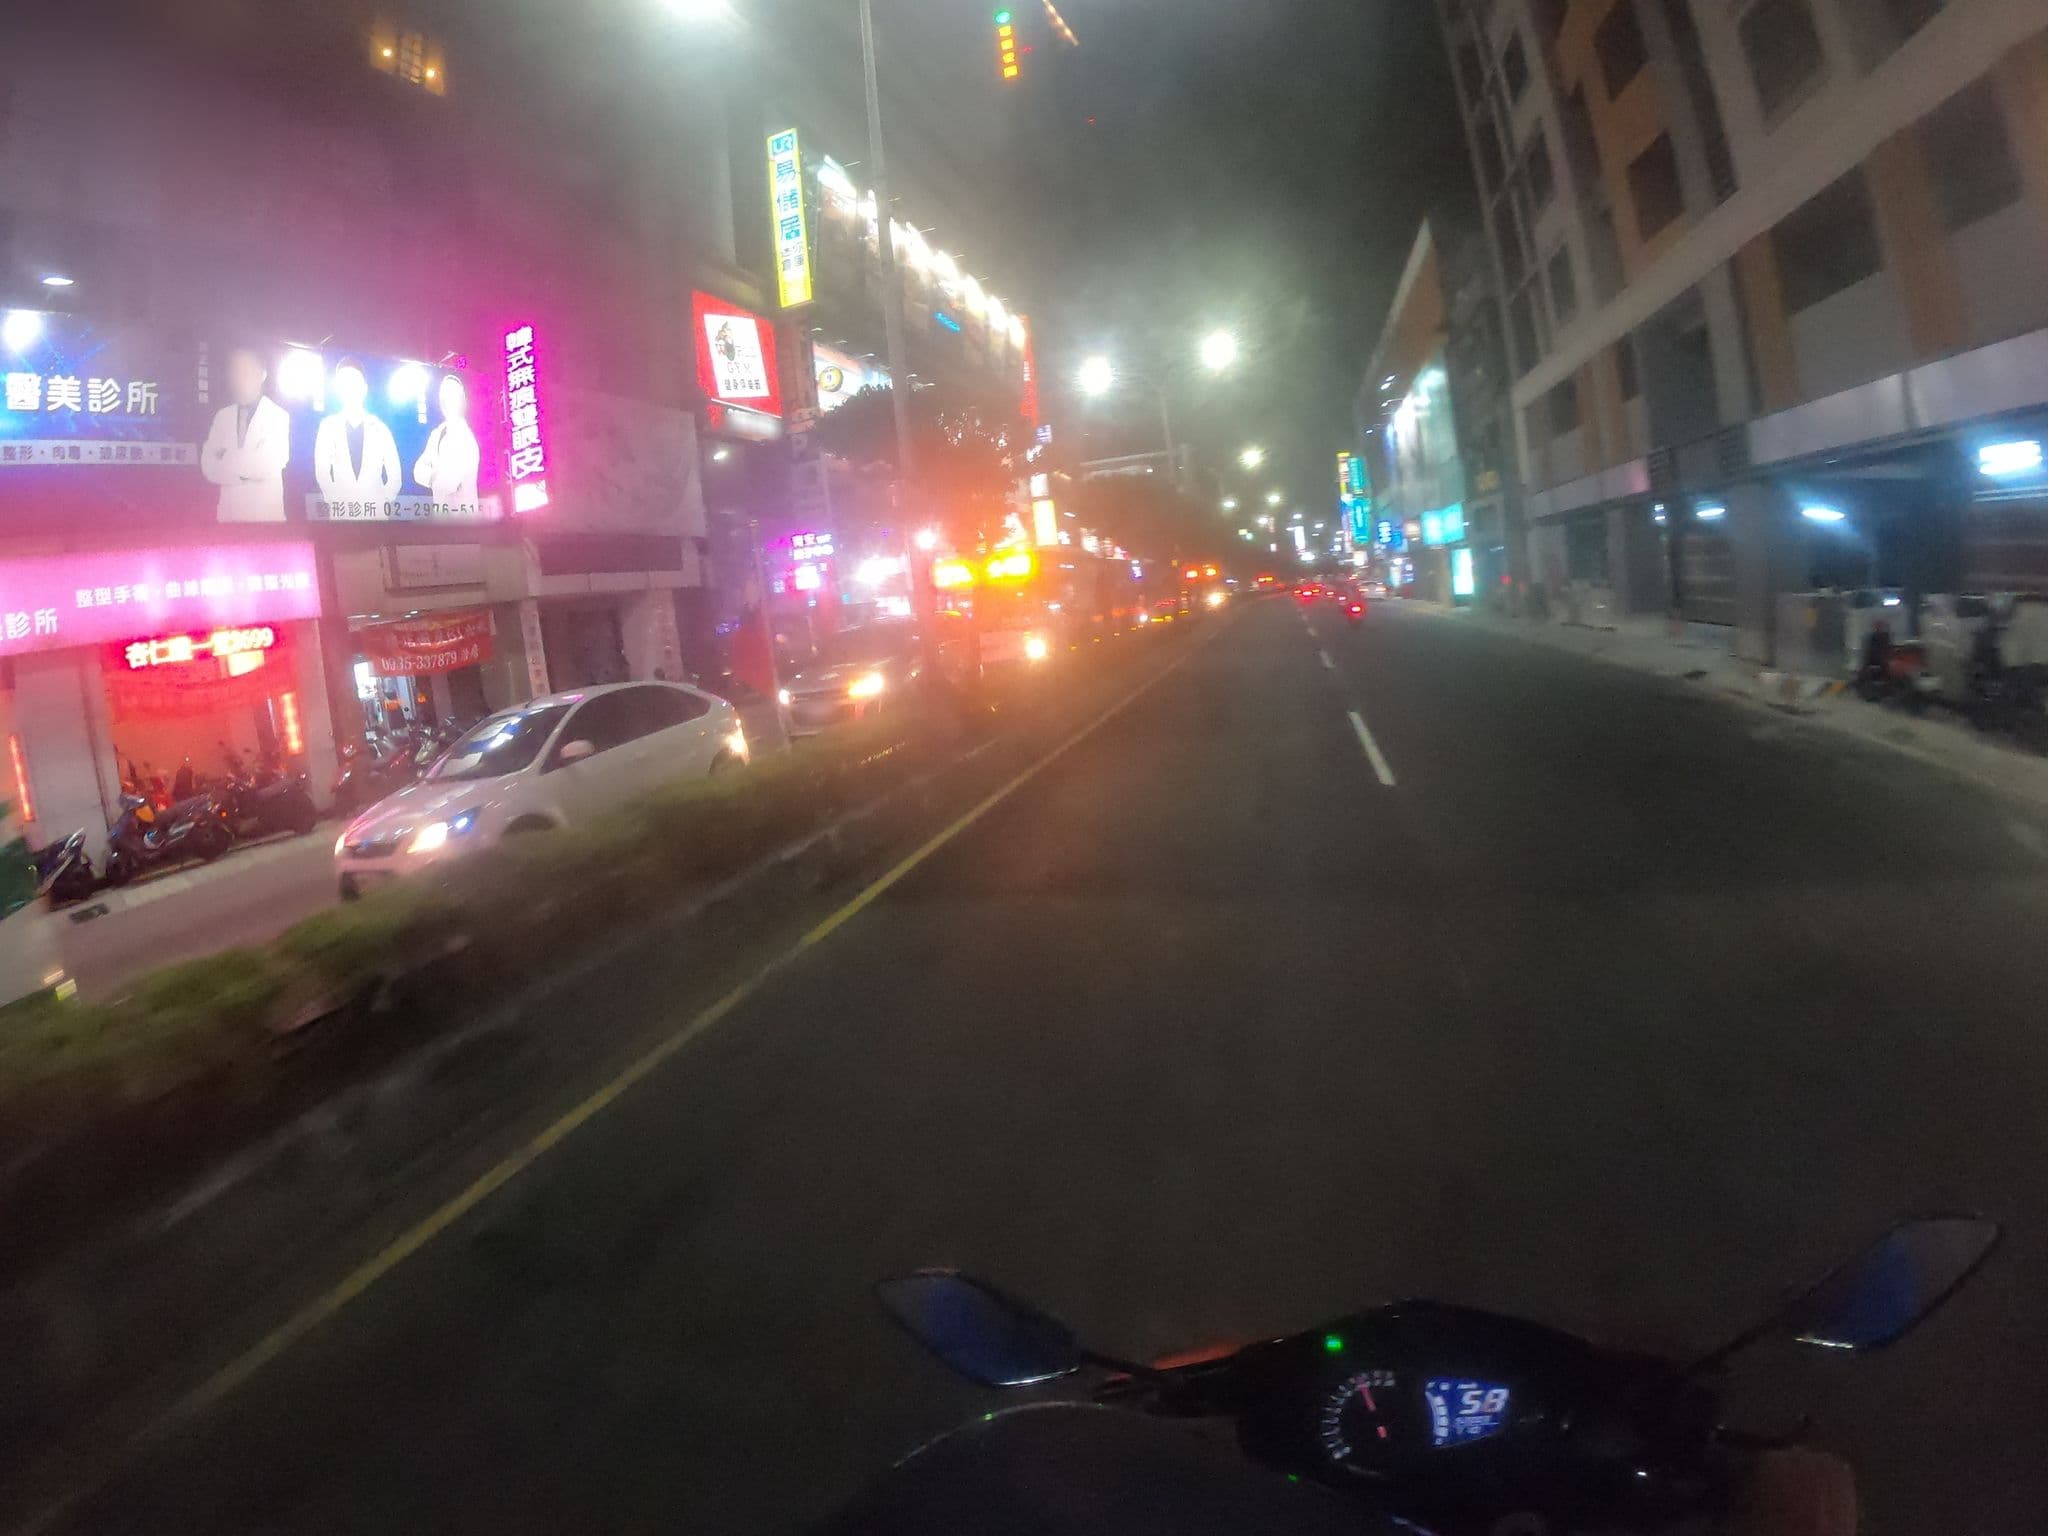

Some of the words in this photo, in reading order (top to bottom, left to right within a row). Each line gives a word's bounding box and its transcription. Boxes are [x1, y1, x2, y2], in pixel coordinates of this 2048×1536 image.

[6, 372, 159, 415] 醫美診所
[383, 502, 496, 518] 02-2976-51
[0, 607, 58, 641] 診所
[1458, 1388, 1509, 1415] 58
